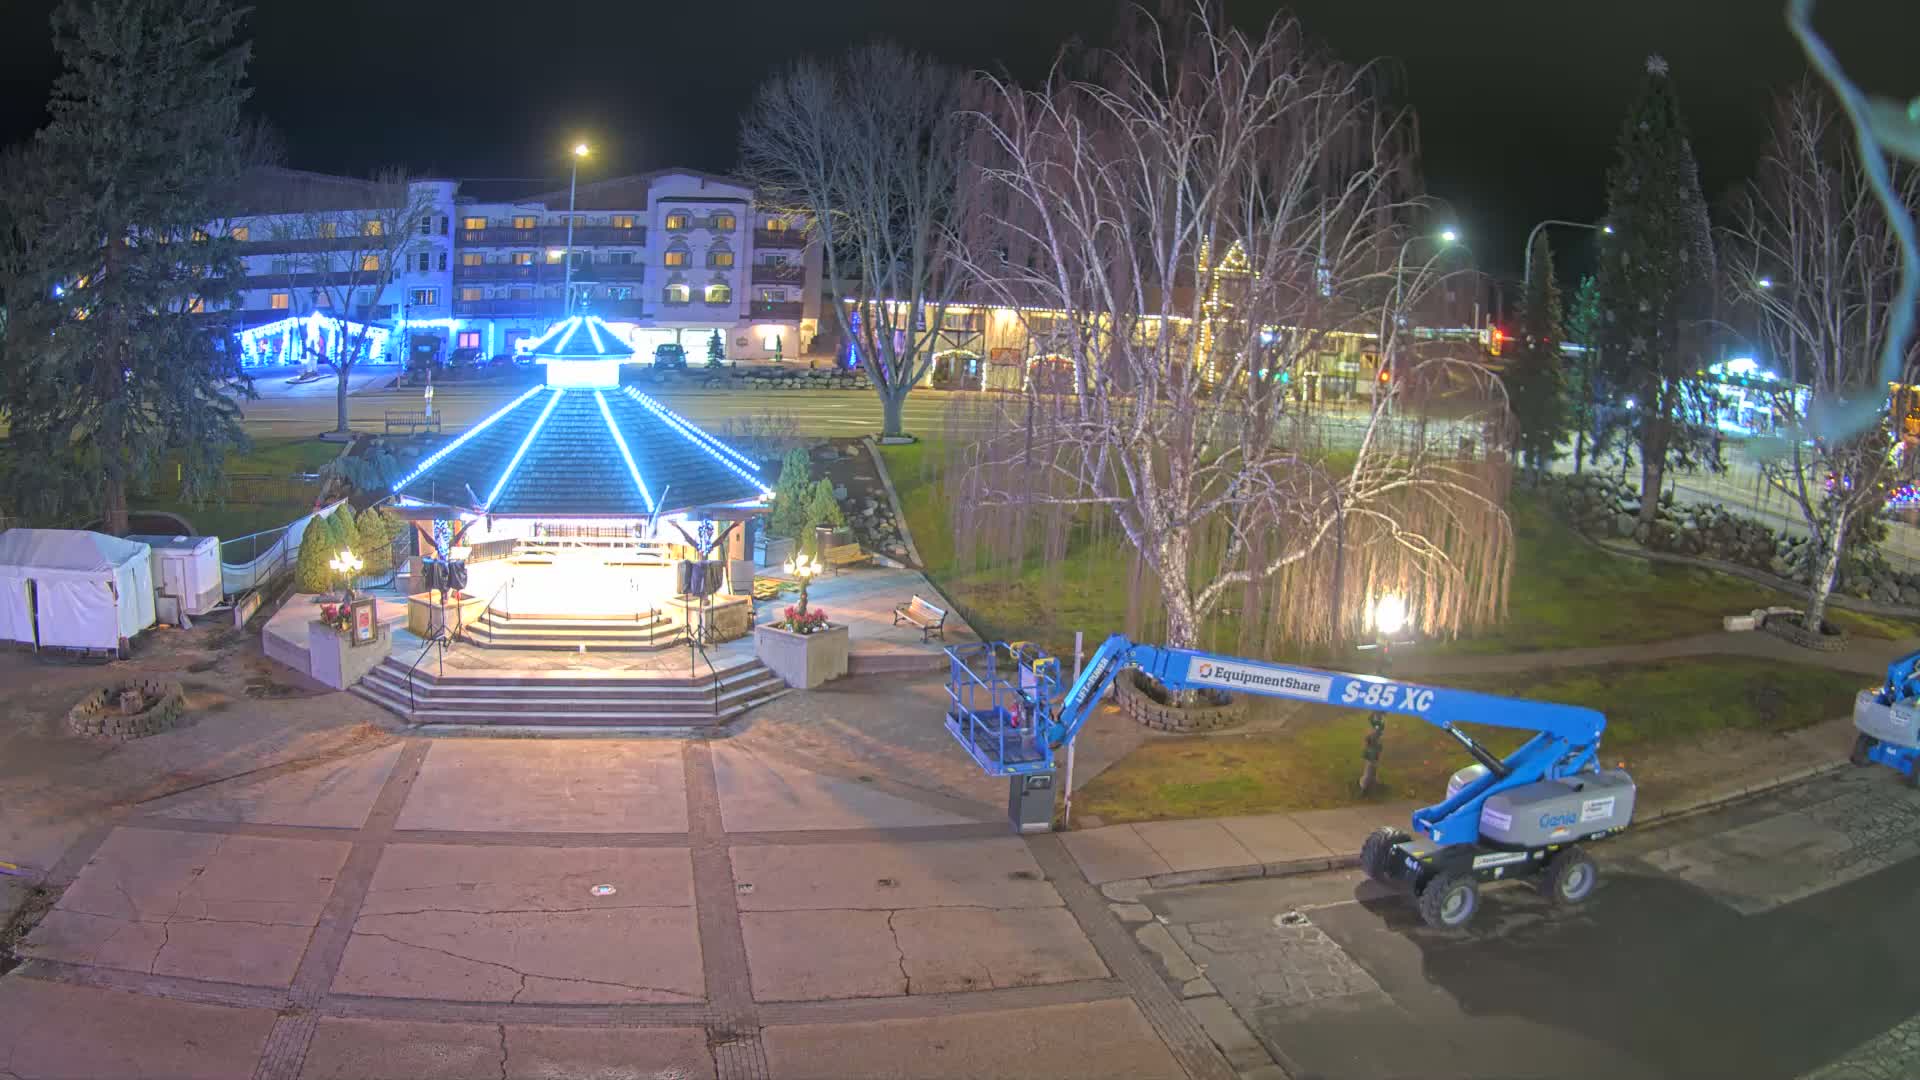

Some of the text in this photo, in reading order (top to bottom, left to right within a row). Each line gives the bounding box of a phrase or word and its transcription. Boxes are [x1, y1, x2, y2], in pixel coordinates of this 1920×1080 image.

[1214, 666, 1320, 692] EquipmentShare
[1342, 681, 1434, 711] S-85 XC
